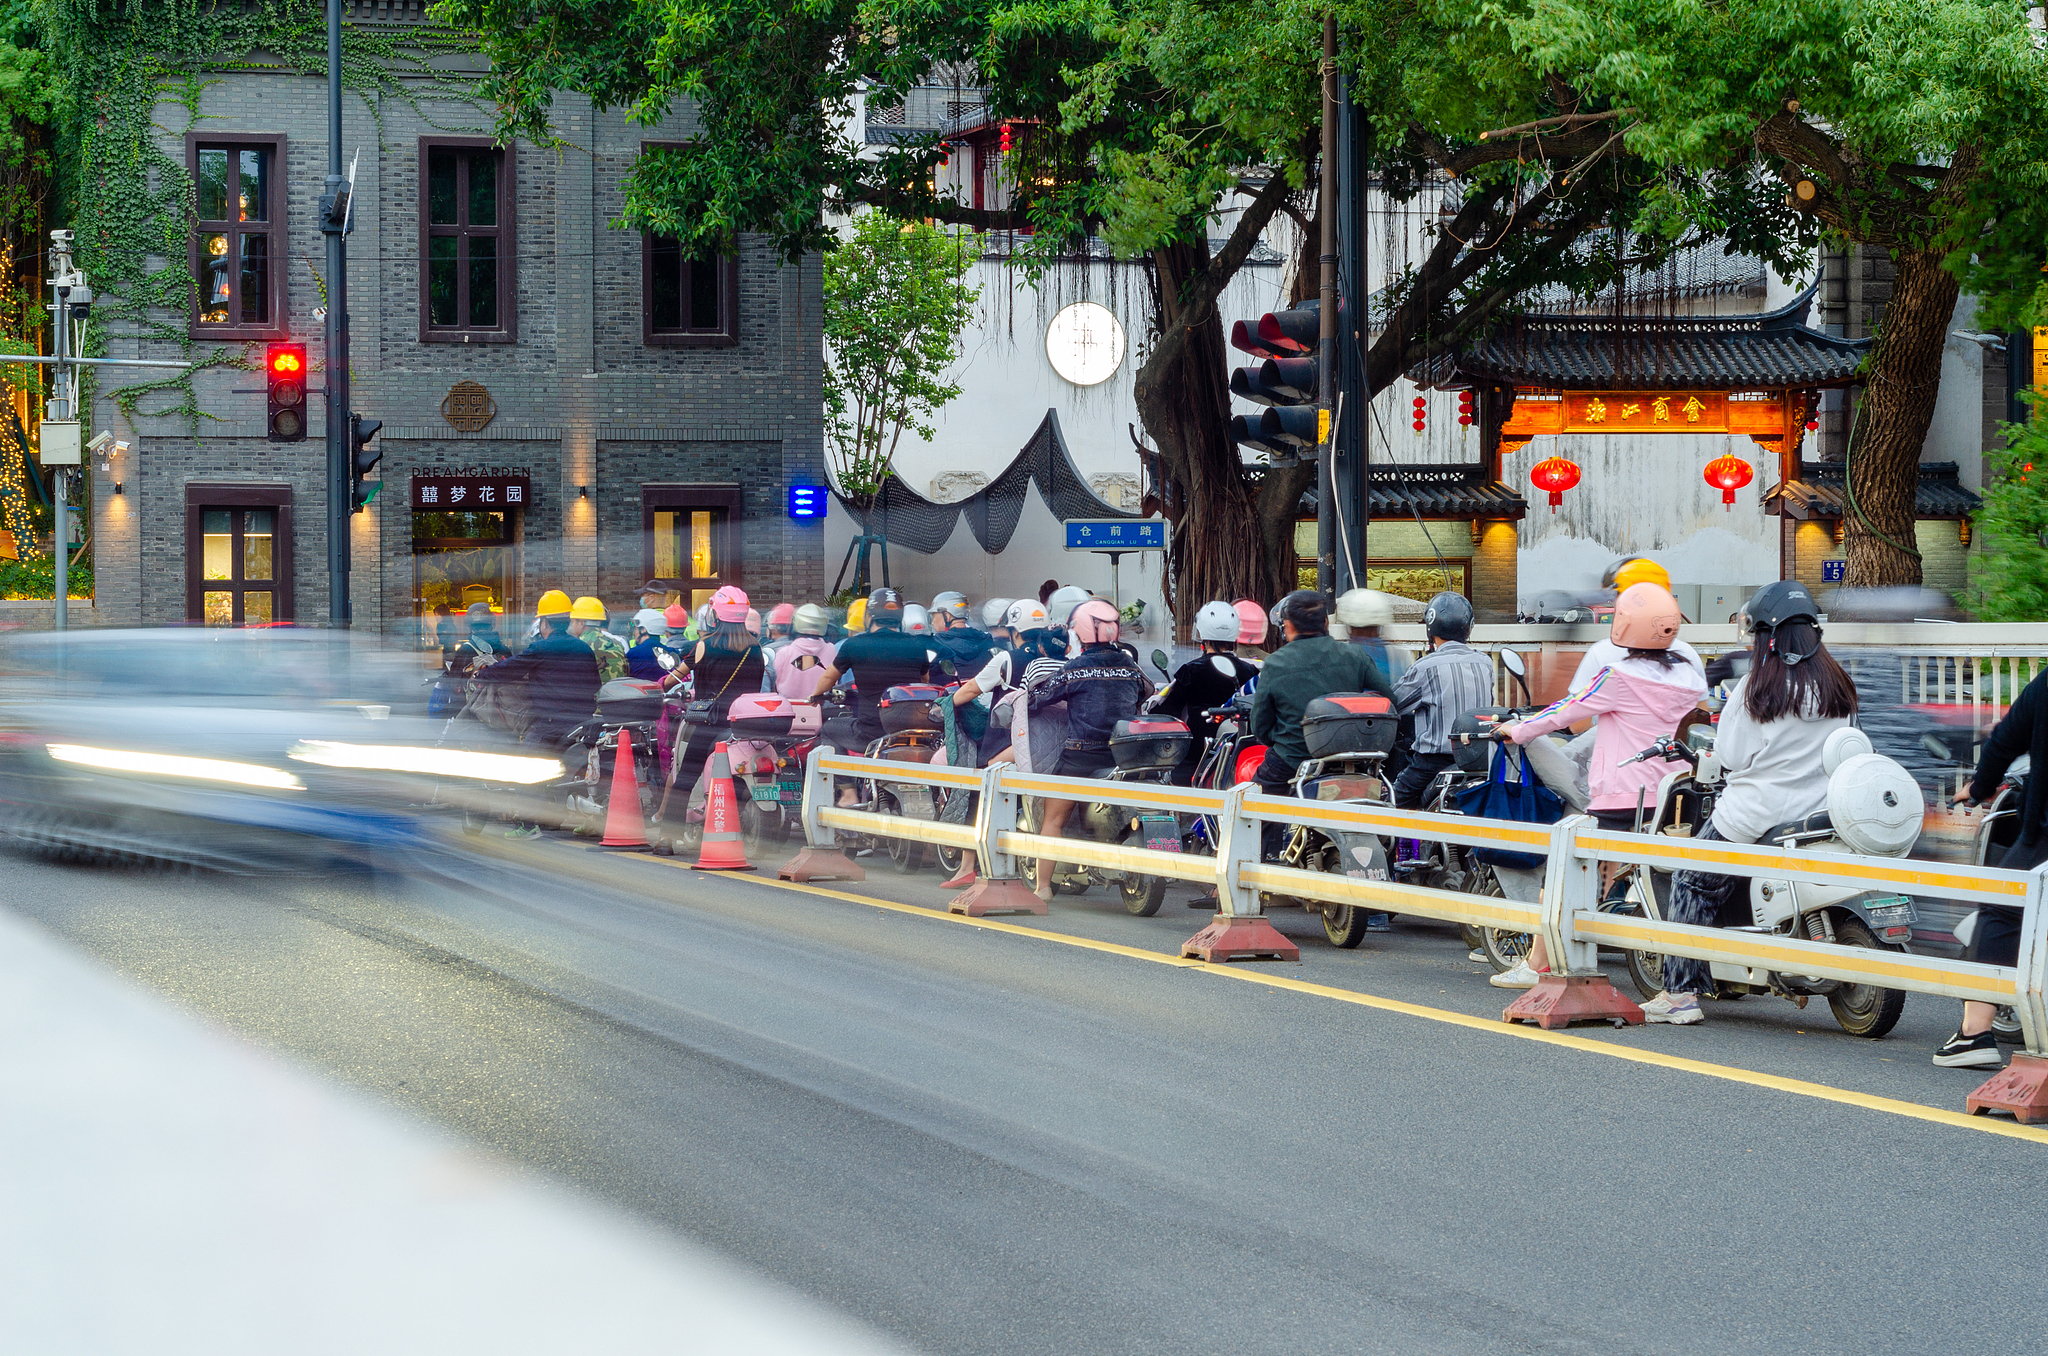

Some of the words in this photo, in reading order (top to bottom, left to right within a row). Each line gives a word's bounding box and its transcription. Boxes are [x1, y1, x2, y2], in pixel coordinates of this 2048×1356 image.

[412, 466, 531, 478] DREAMGARDEN
[1080, 525, 1152, 537] 仓前路
[713, 783, 725, 833] 福州交警
